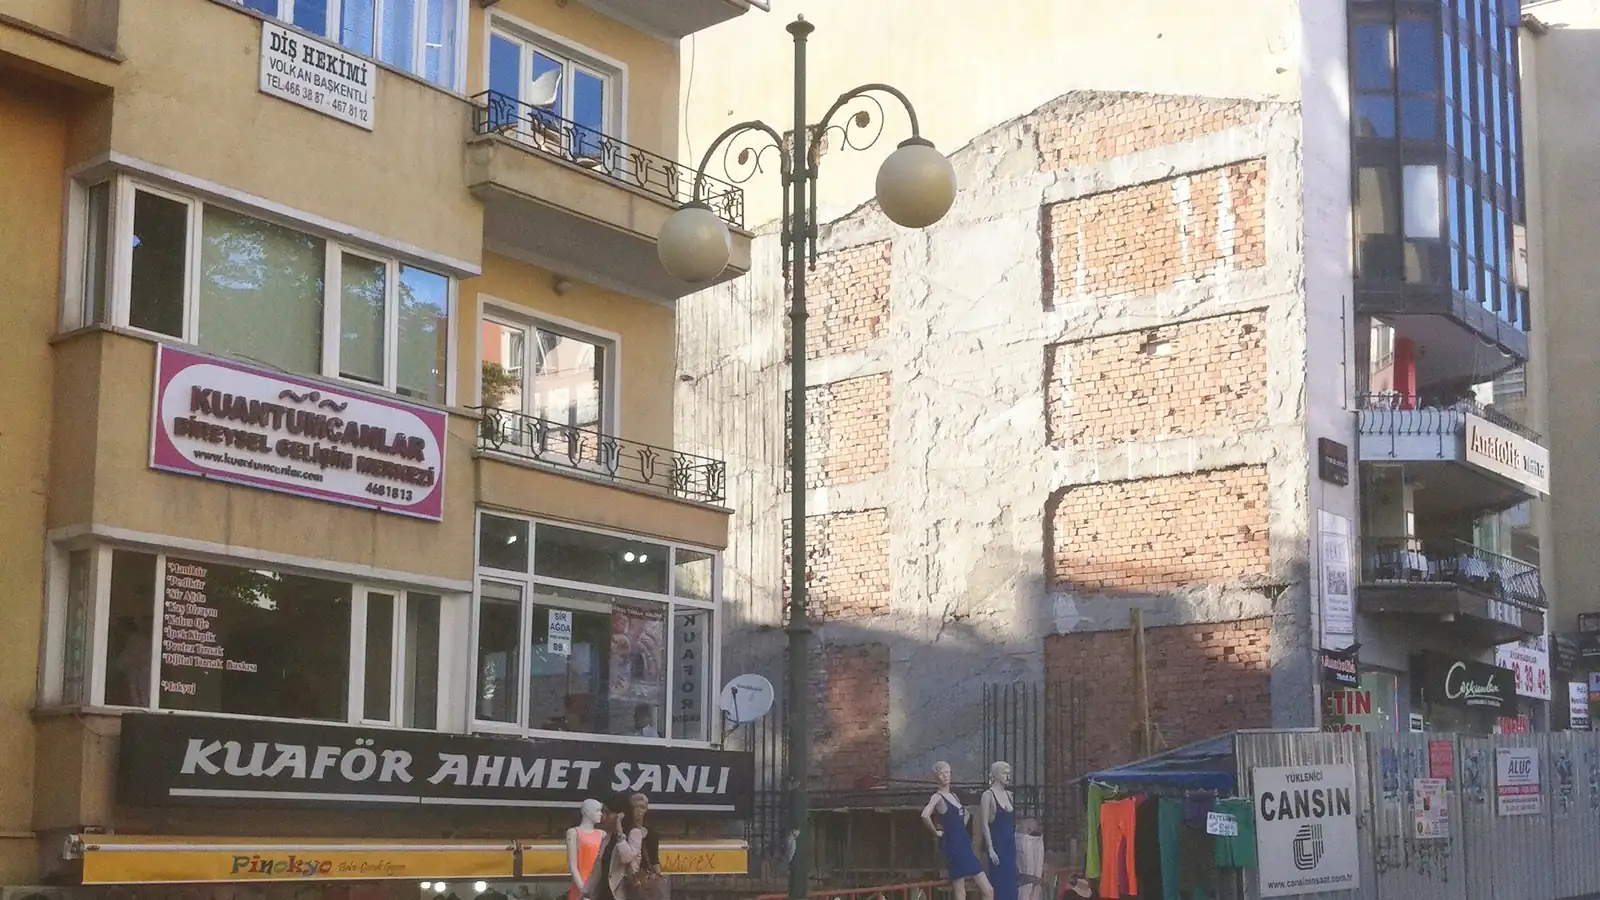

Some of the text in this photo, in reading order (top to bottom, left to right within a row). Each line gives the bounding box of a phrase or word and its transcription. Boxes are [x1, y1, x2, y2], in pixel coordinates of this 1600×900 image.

[270, 31, 368, 86] DİŞ HEKİMİ
[269, 56, 368, 105] VOLKAN BAŞKENTLİ
[302, 87, 313, 101] 38
[315, 92, 325, 105] 87
[331, 99, 348, 114] 467
[348, 105, 358, 118] 81
[359, 109, 368, 122] 12
[190, 385, 426, 462] KUANTUMCANLAR
[173, 415, 273, 453] BİREYSEL
[356, 455, 435, 488] MERKEZİ
[365, 483, 413, 502] 4681813
[550, 622, 571, 633] AĞDA
[180, 737, 730, 794] KUAFÖR AHMET SANLI
[1285, 771, 1323, 784] YÜKLENİCİ
[1260, 787, 1351, 822] CANSIN
[230, 855, 333, 877] Pinokyo
